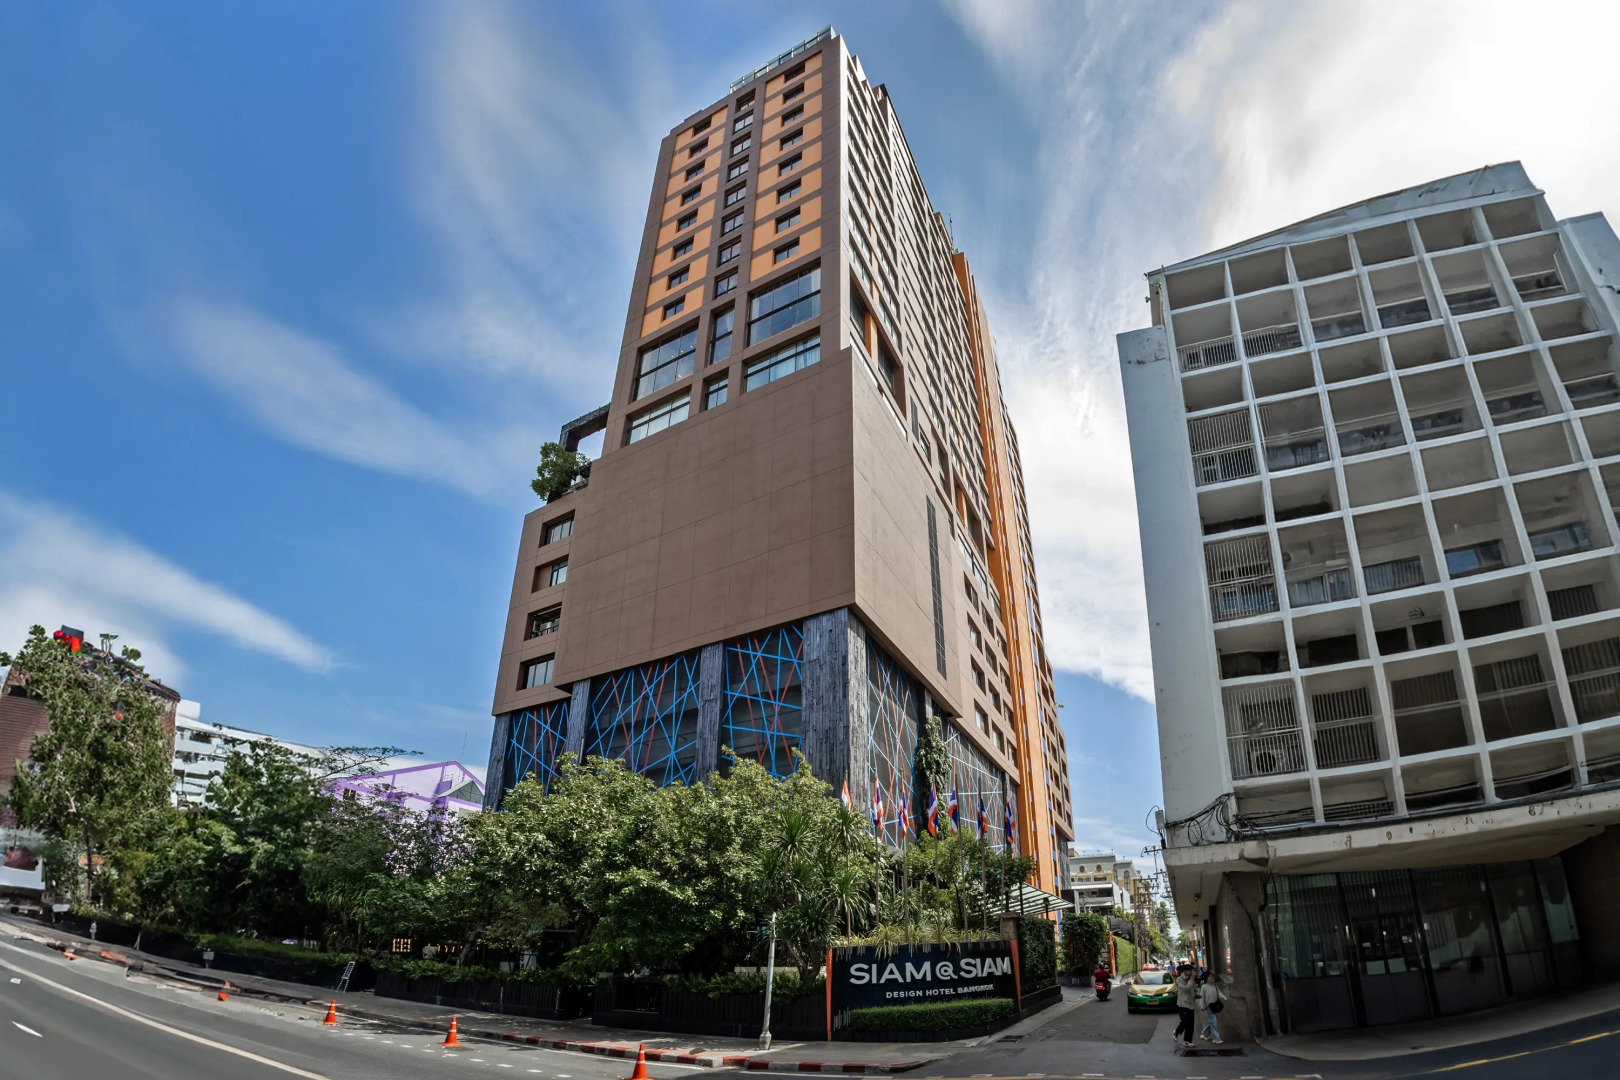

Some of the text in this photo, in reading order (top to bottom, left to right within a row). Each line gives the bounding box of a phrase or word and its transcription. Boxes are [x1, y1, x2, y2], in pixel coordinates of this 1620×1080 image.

[886, 984, 994, 999] DESIGN HOTEL BANGKOK
